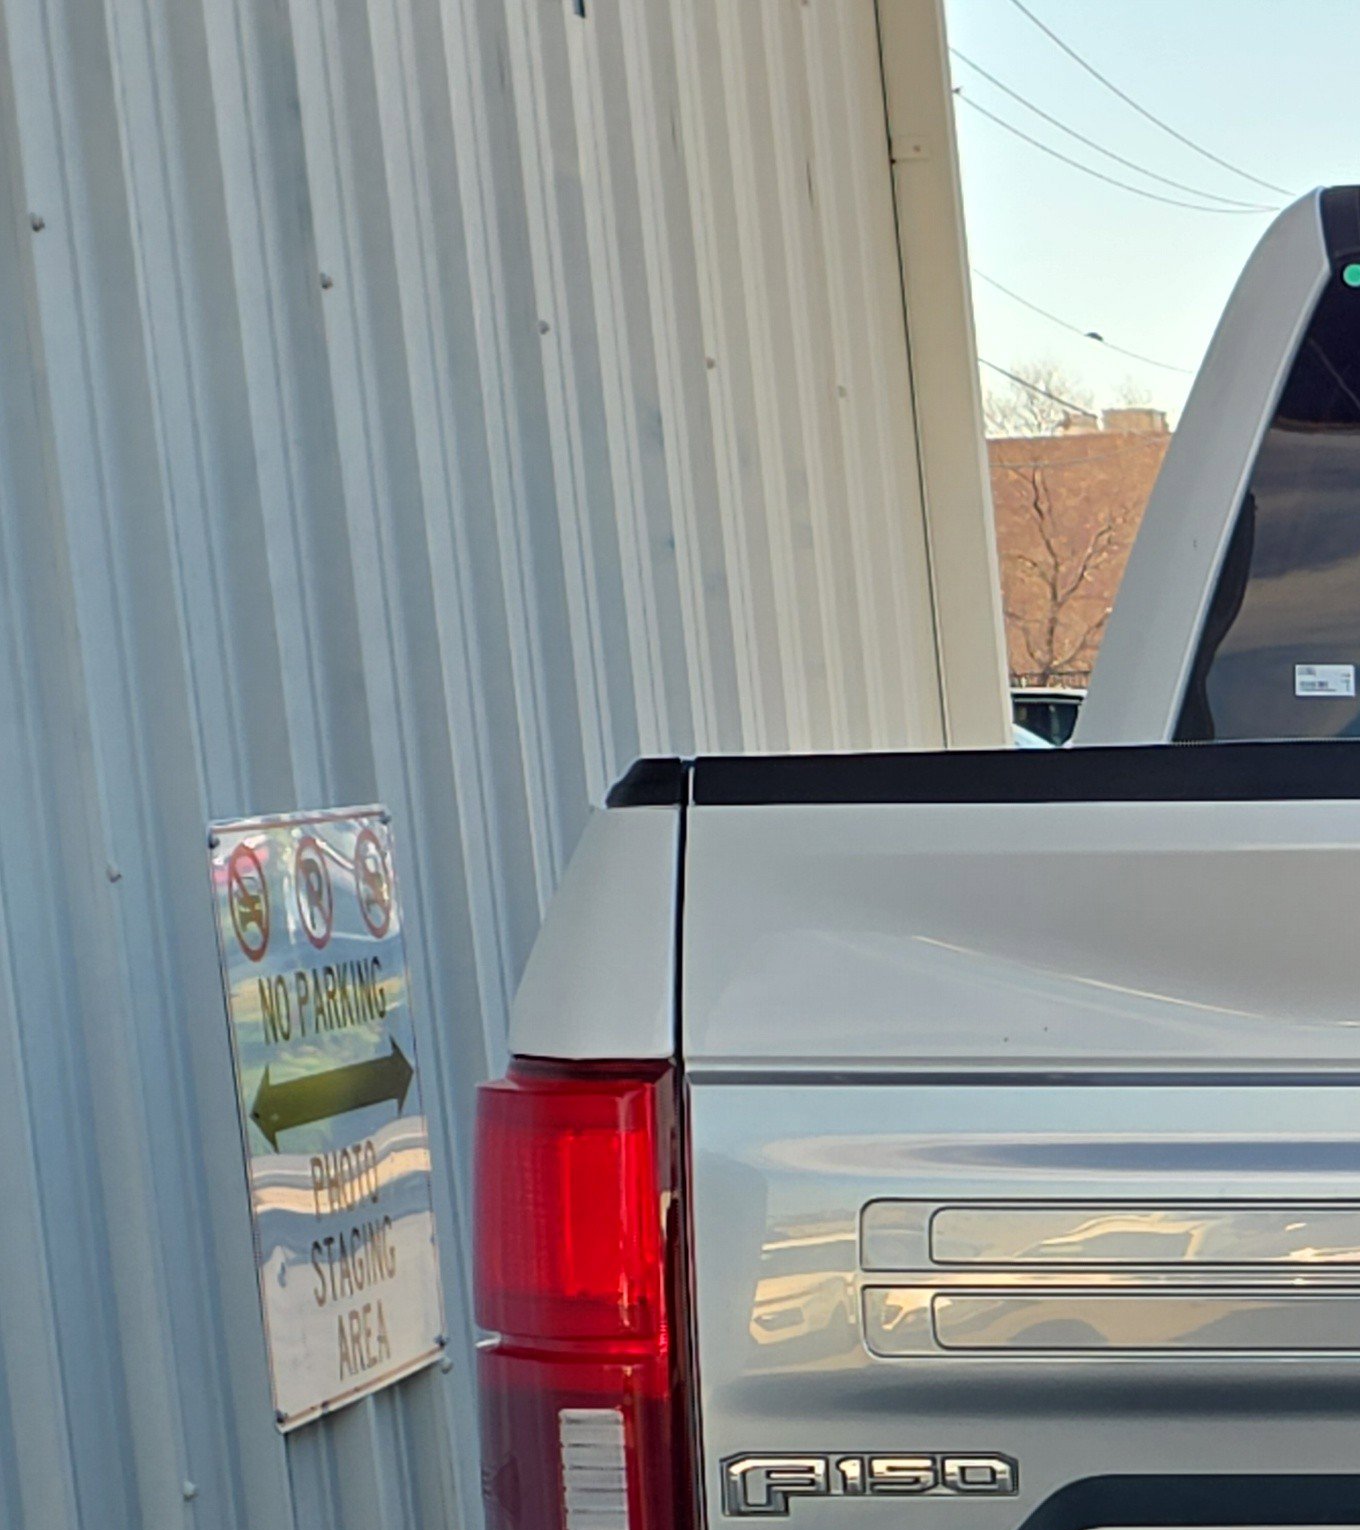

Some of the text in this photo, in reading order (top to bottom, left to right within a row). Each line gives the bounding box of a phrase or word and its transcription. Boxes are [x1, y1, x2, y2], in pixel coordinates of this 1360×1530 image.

[258, 955, 386, 1045] NO PARKING
[310, 1139, 379, 1222] PHOTO
[311, 1215, 396, 1307] STAGING
[337, 1299, 391, 1381] AREA
